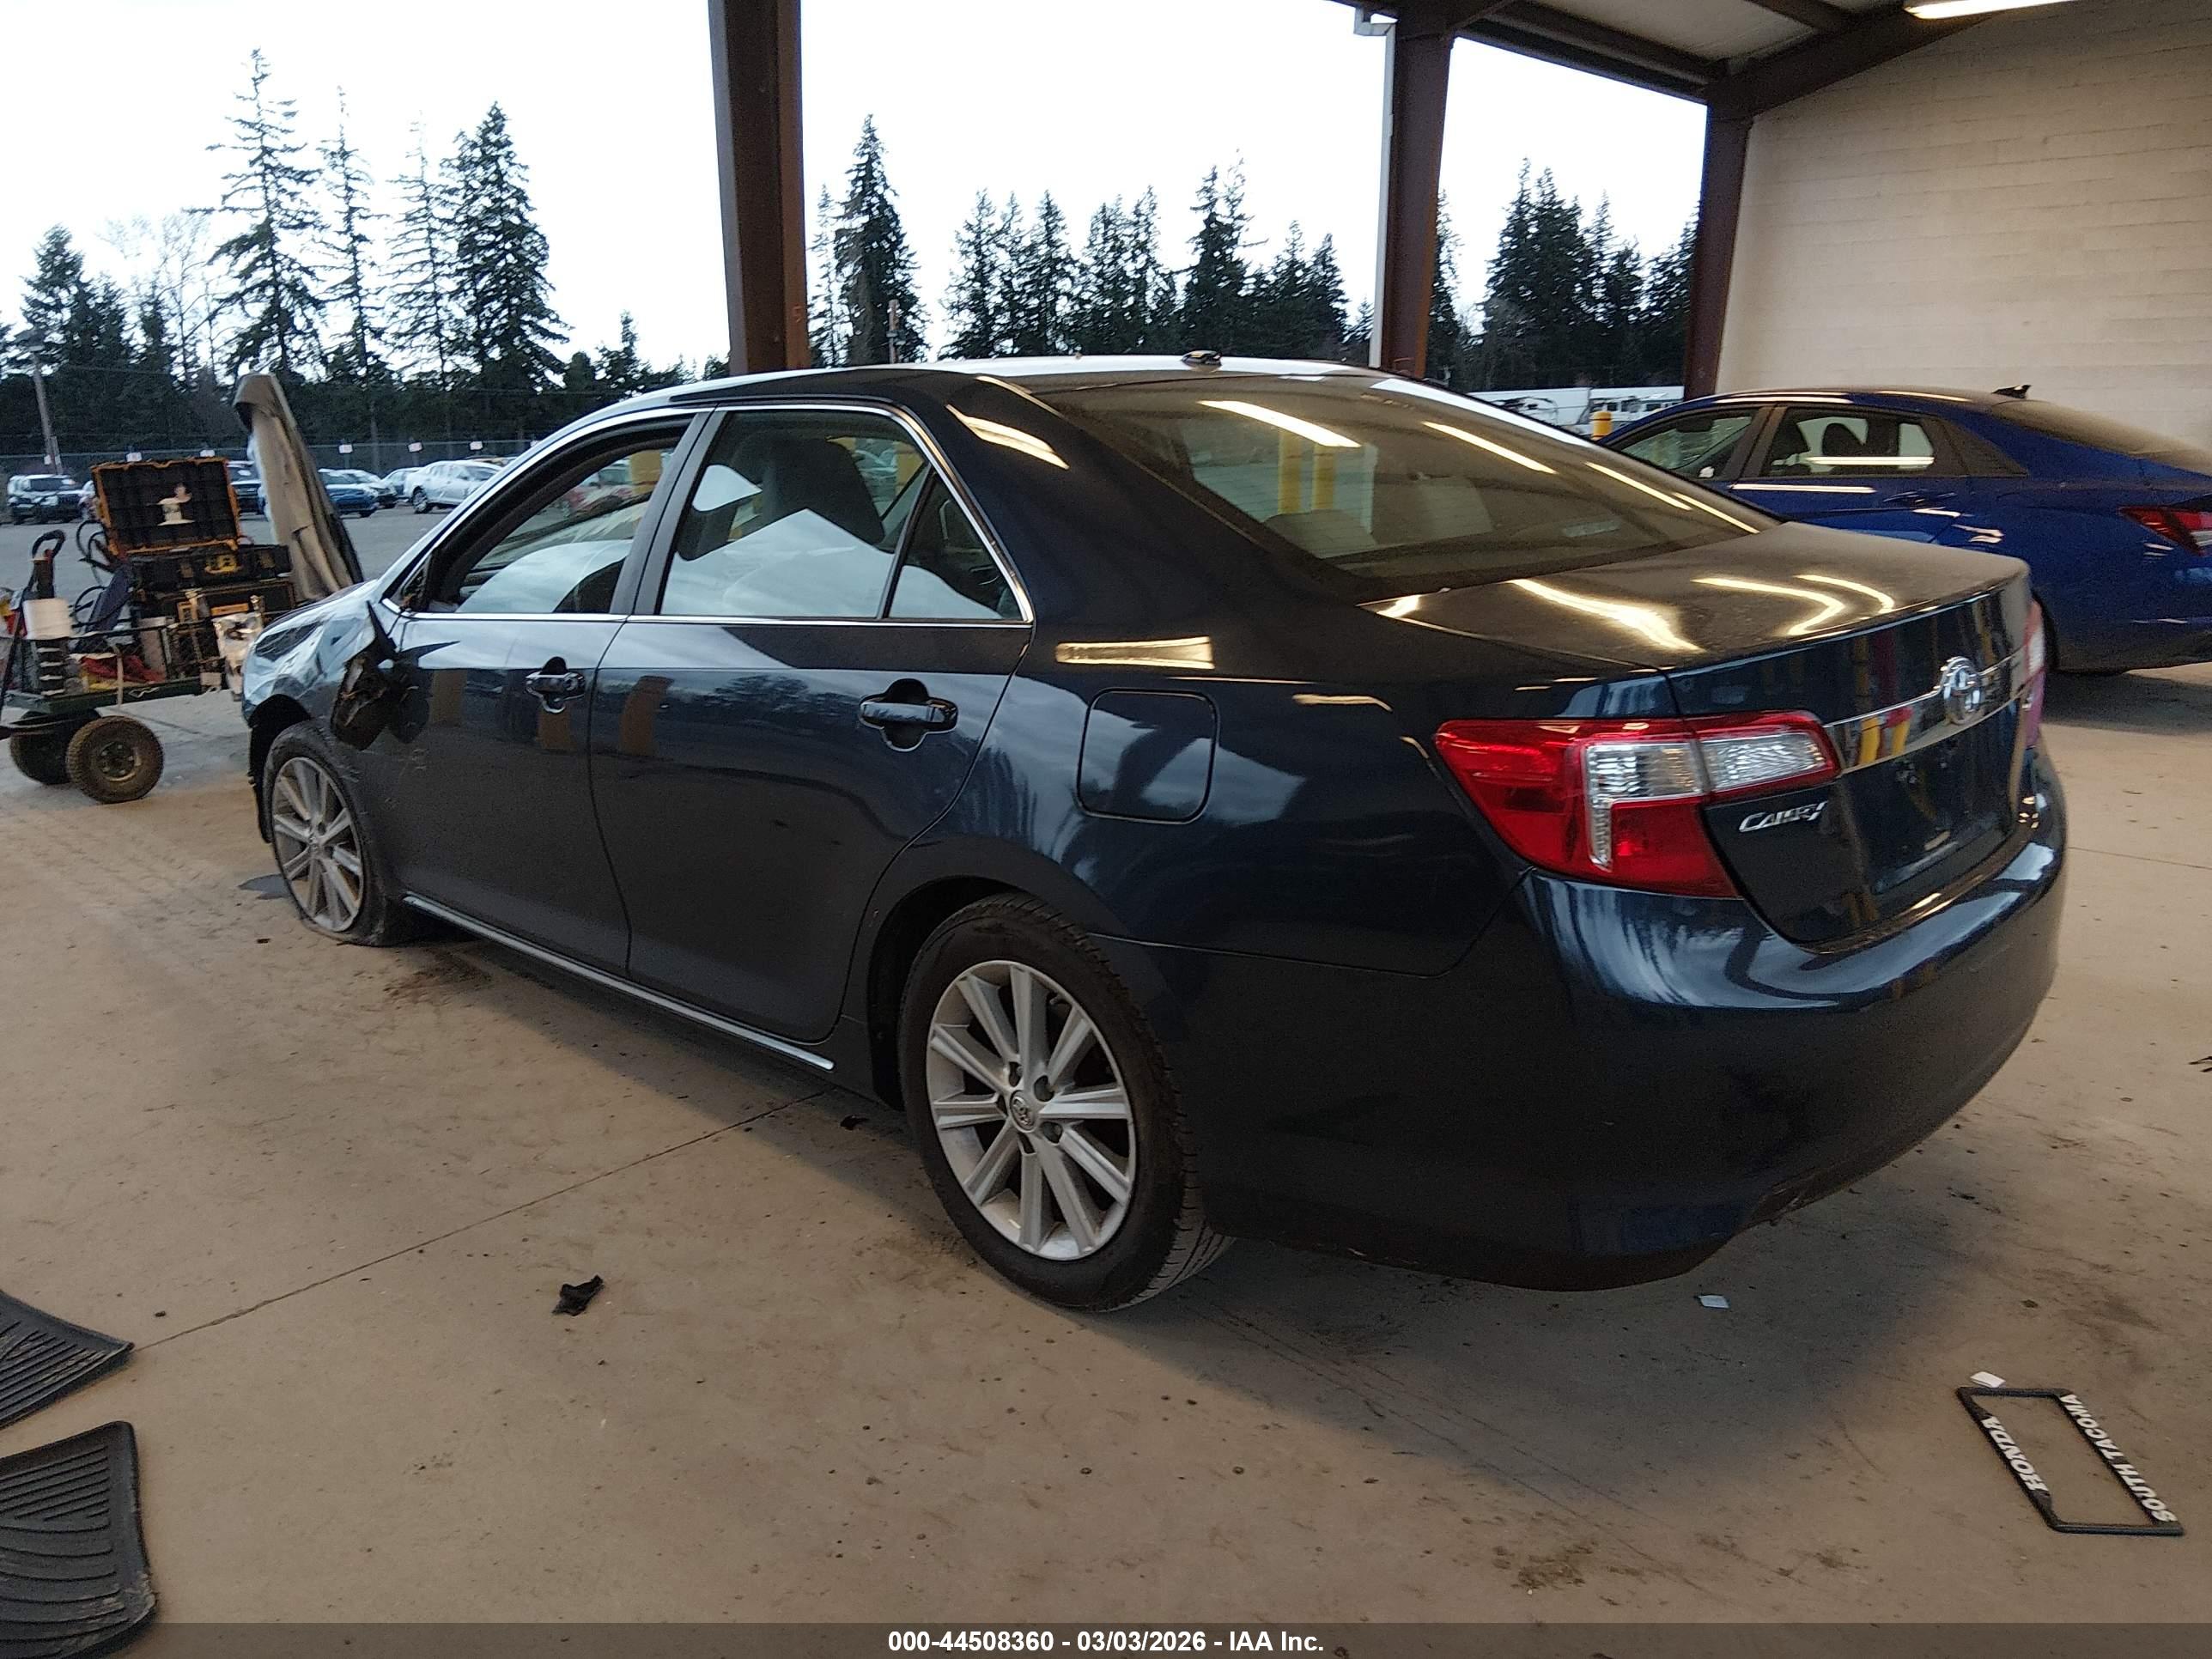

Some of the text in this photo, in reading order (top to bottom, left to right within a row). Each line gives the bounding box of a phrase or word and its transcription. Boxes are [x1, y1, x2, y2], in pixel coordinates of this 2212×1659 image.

[1981, 1416, 2049, 1492] HONDA
[2060, 1394, 2177, 1522] SOUTH TACOMA
